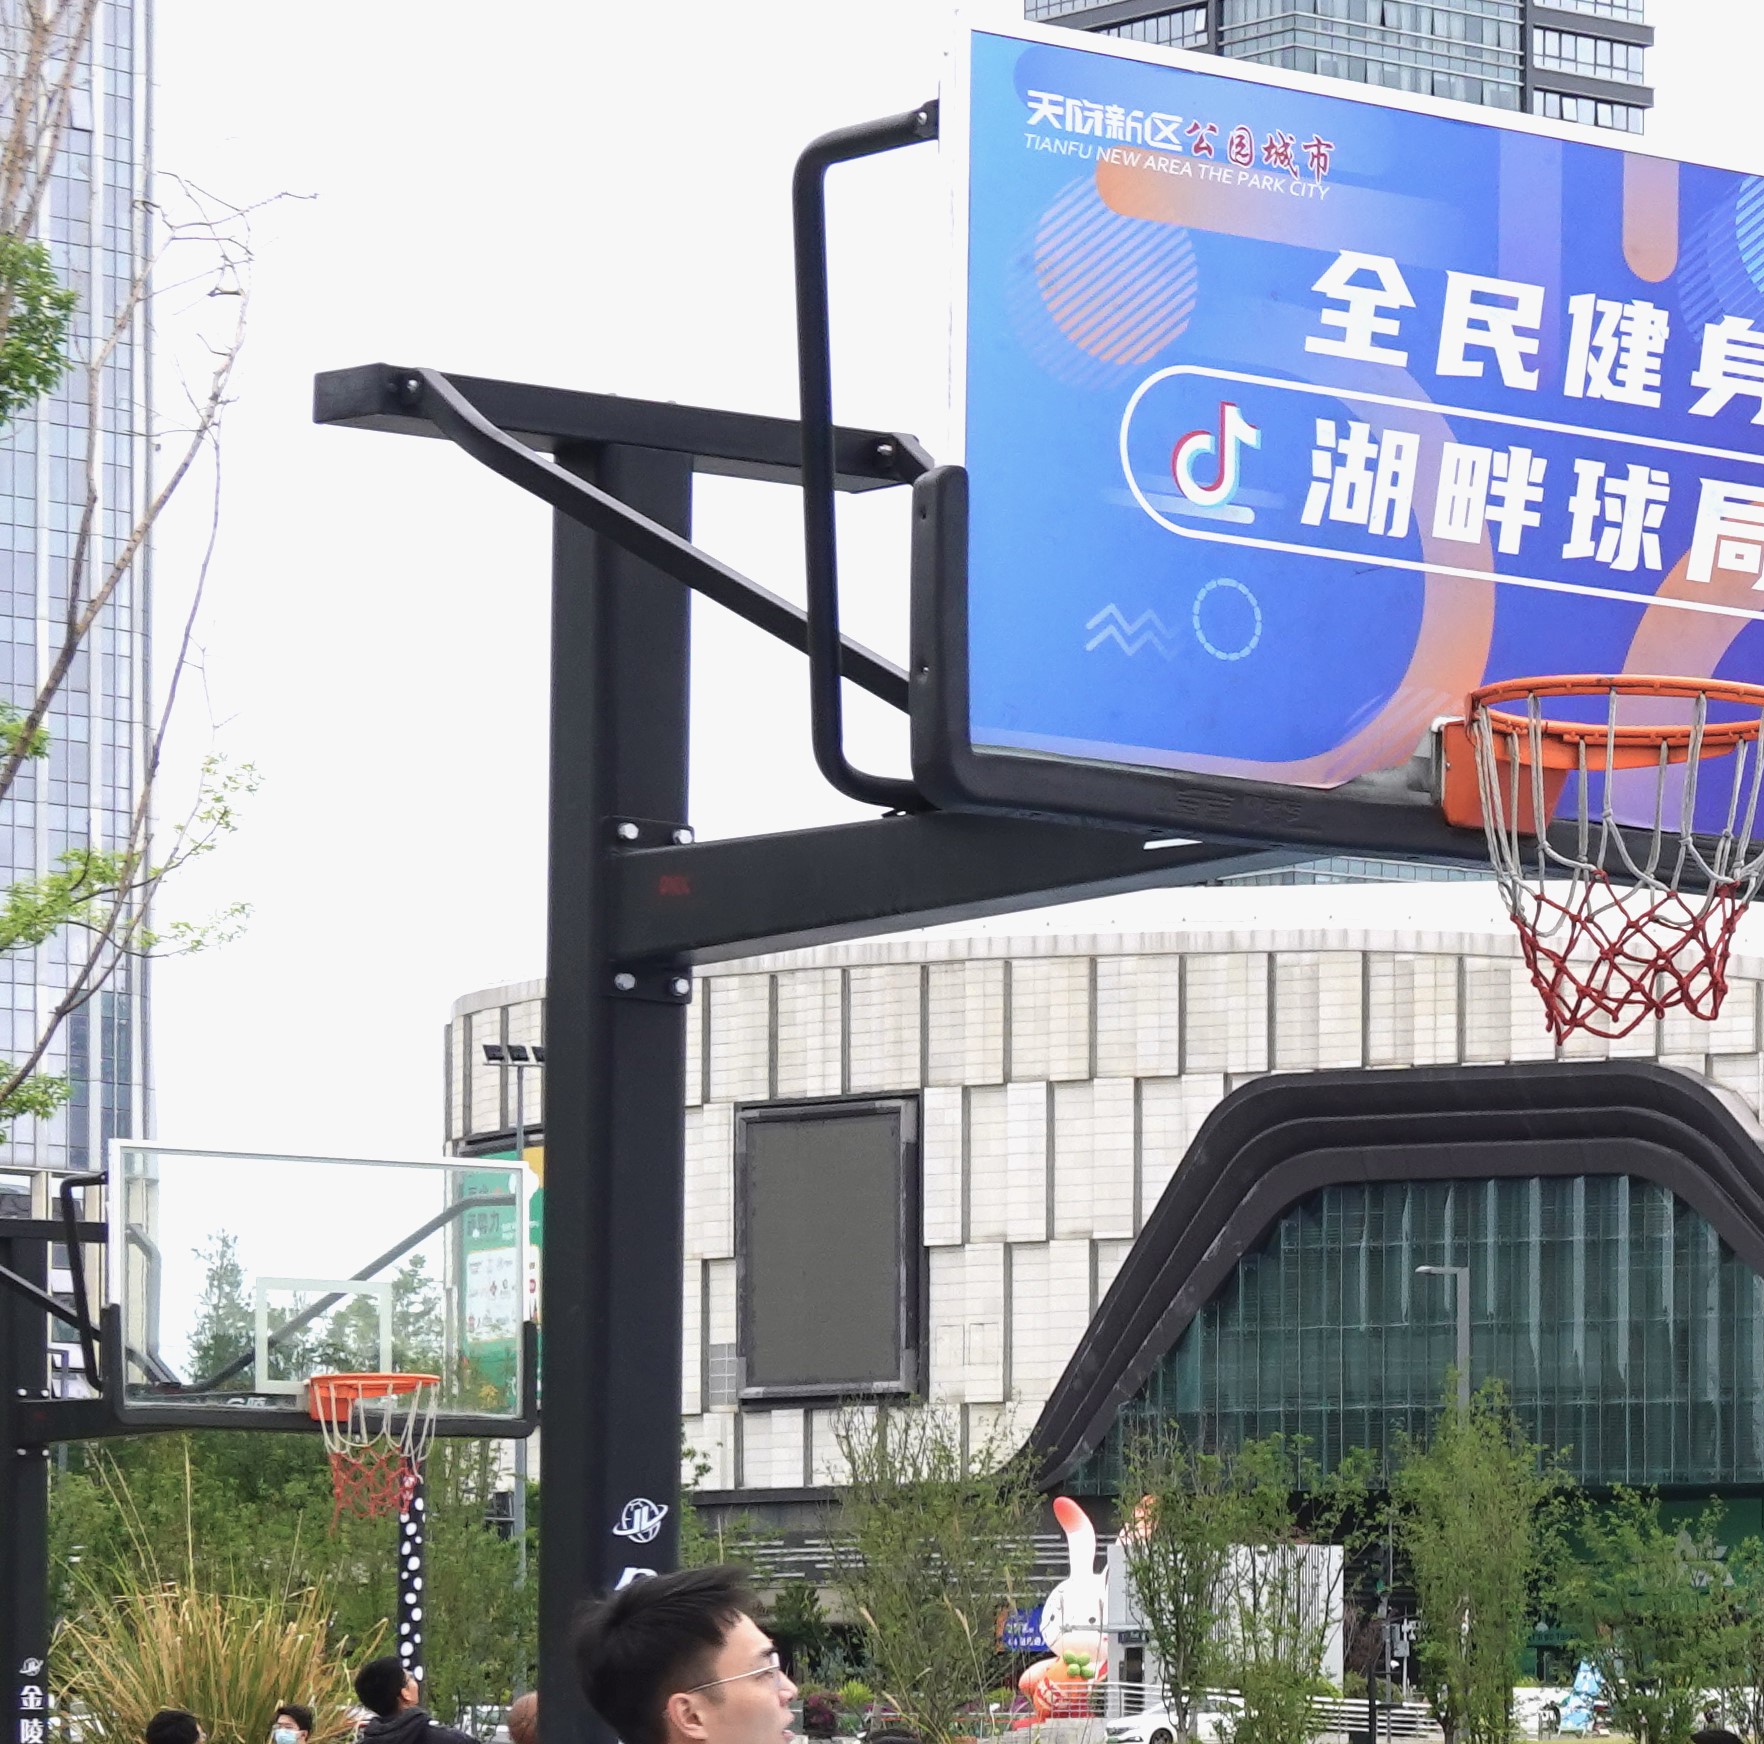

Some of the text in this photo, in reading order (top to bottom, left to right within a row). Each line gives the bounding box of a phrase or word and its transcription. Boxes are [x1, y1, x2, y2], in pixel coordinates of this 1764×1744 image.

[1023, 132, 1330, 201] TIANFU NEW AREA THE PARK CITY
[1026, 89, 1335, 184] 天府新区 公园城市
